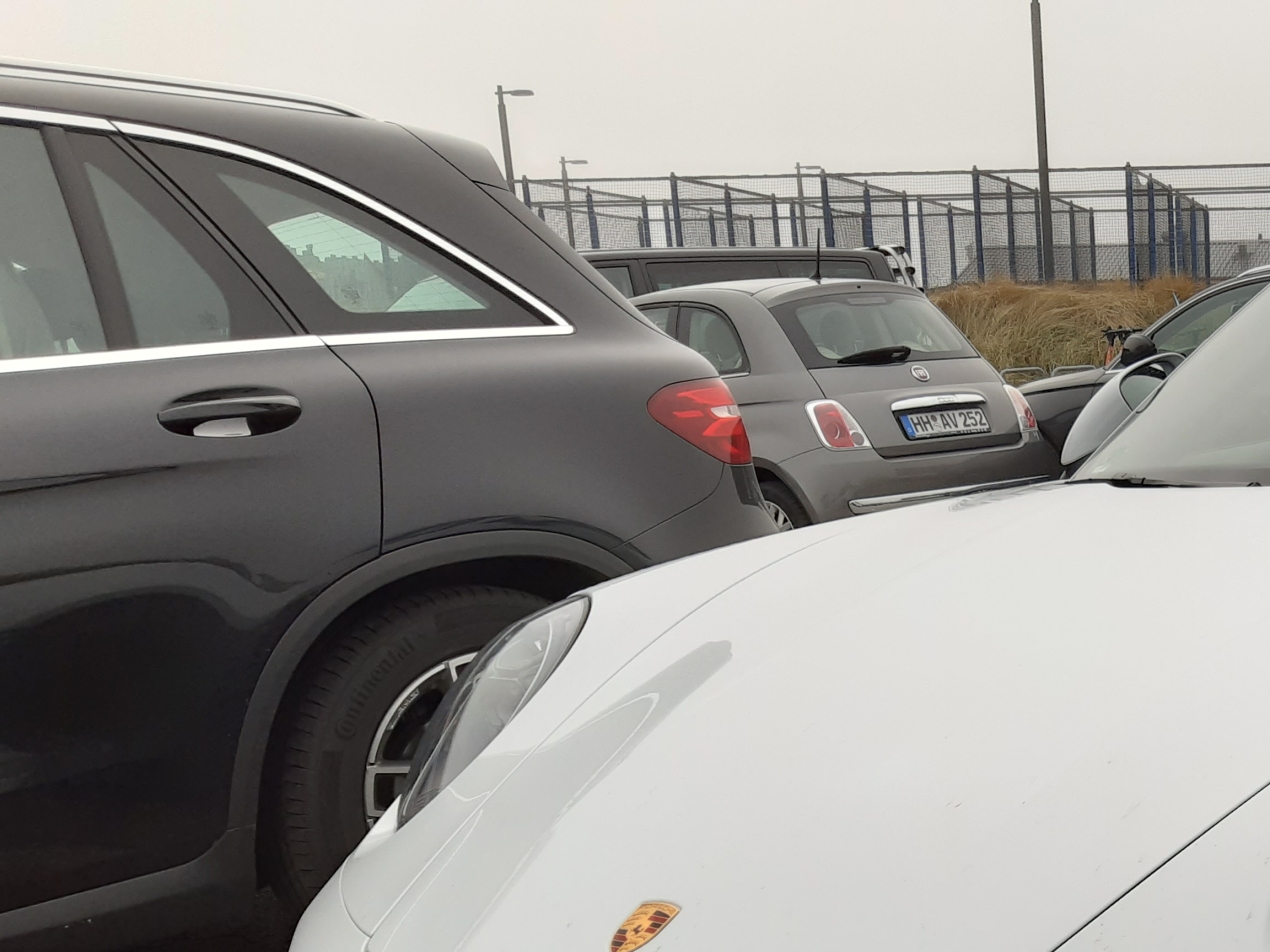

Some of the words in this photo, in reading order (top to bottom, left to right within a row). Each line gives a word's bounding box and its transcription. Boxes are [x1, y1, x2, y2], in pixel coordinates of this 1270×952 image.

[910, 415, 934, 433] HH
[940, 412, 959, 430] AV
[958, 410, 987, 428] 252
